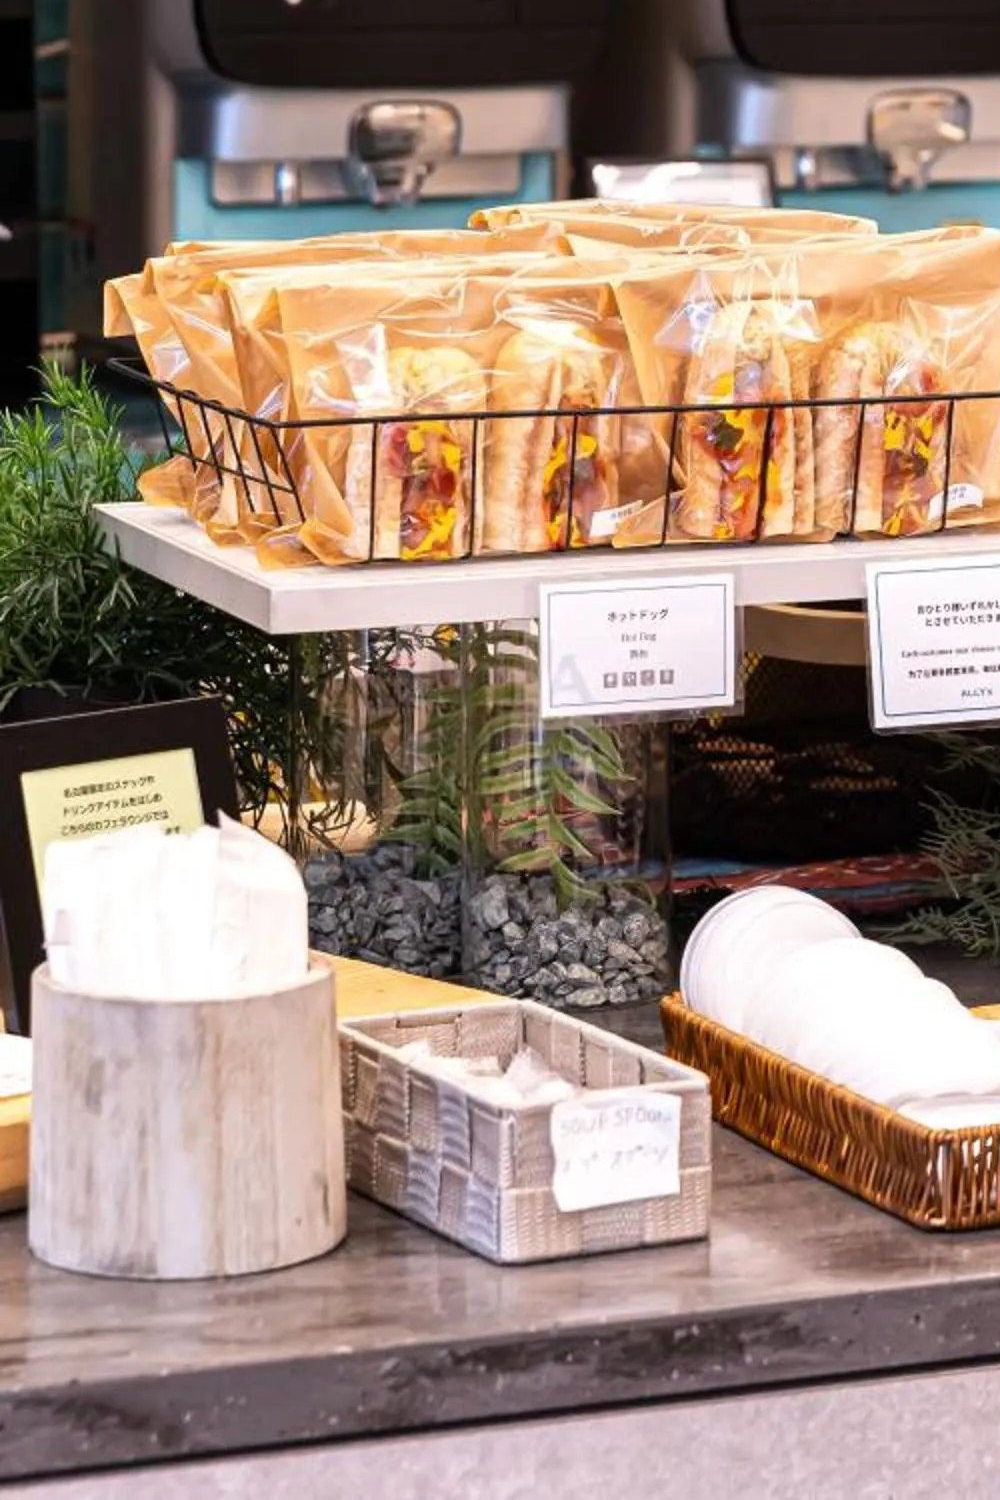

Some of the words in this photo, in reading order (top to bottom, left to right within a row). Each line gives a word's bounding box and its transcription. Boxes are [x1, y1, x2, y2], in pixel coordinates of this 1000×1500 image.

[607, 608, 669, 622] ホットドッグ
